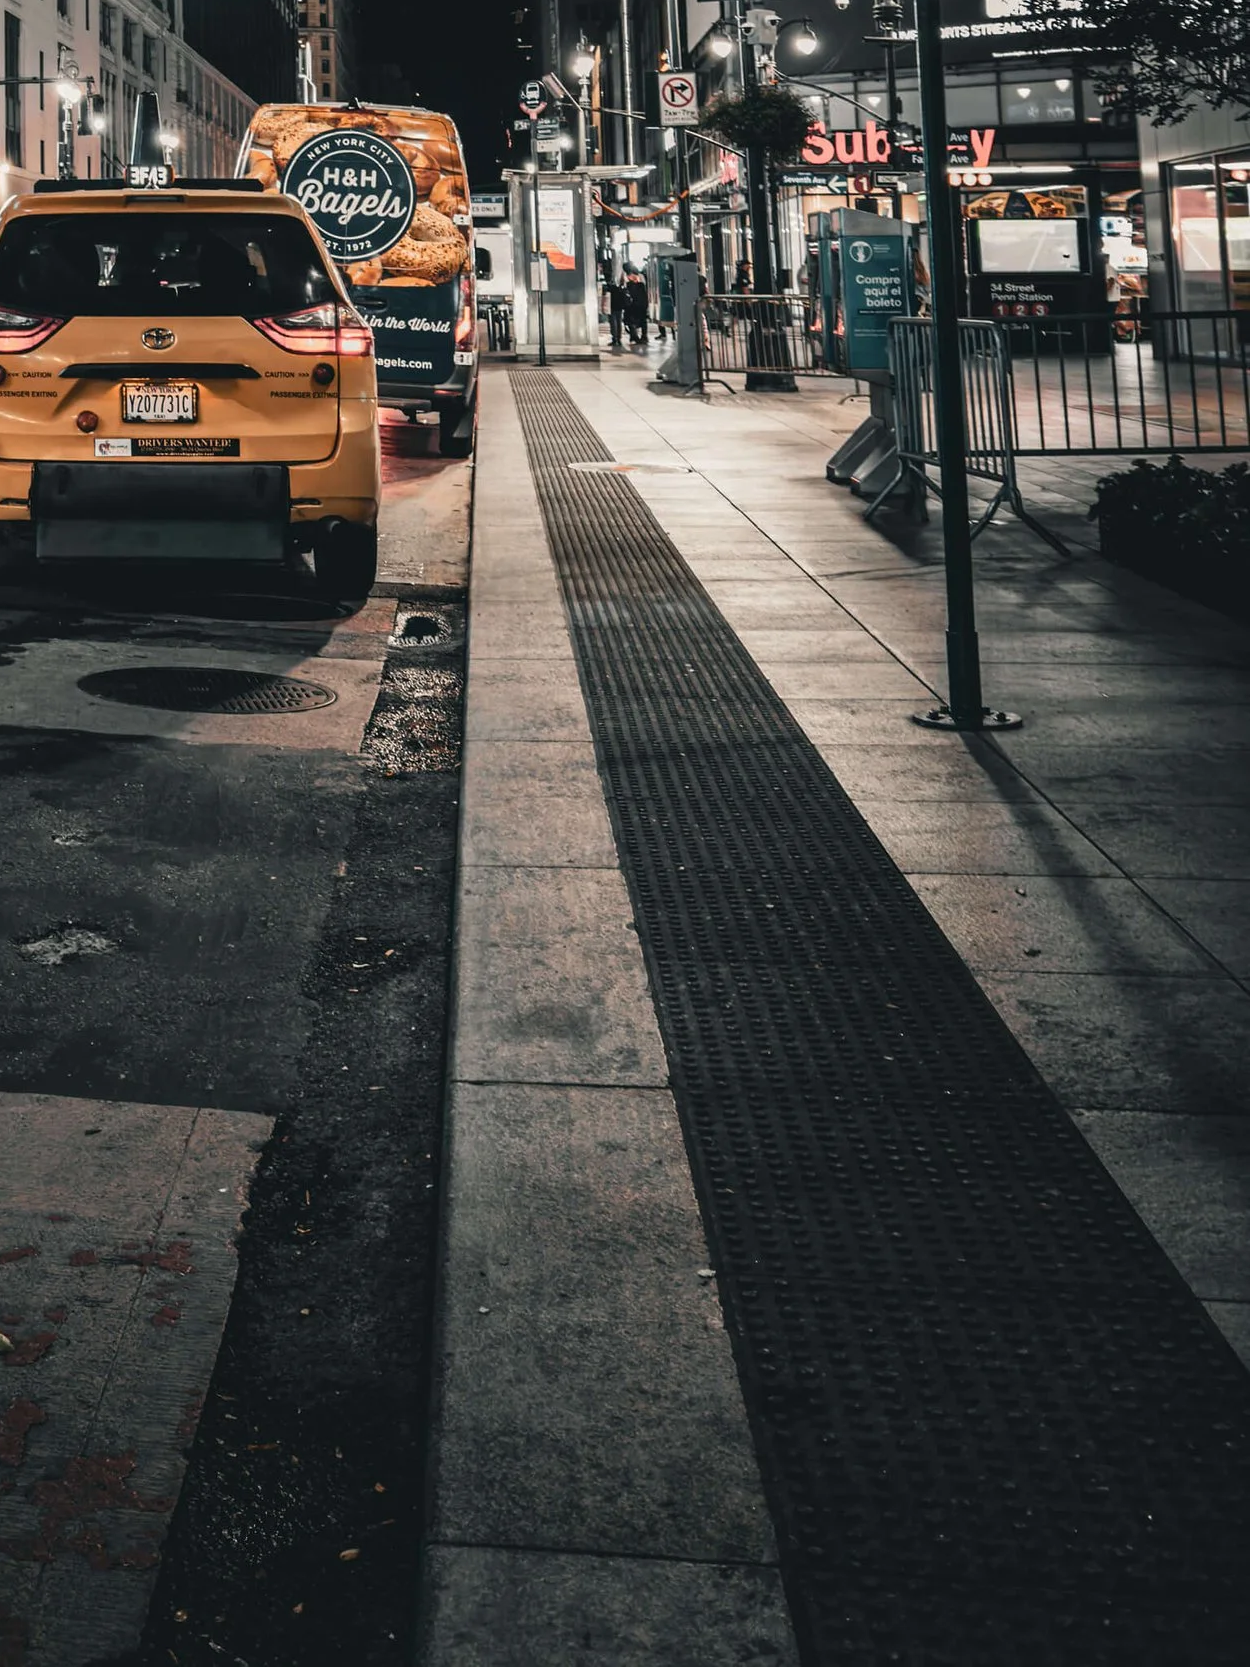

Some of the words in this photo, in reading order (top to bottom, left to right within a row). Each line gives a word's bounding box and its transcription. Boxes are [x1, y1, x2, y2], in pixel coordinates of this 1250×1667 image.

[950, 134, 969, 142] Ave
[802, 120, 995, 168] Suby
[306, 141, 330, 160] NEW
[334, 138, 366, 149] YORK
[369, 144, 394, 165] CITY
[950, 155, 969, 164] Ave
[323, 167, 378, 188] H&H
[783, 175, 812, 184] Seventh
[859, 177, 868, 191] 1
[297, 178, 407, 225] Bagels
[346, 240, 372, 252] 1972
[855, 275, 901, 285] Compre
[891, 286, 901, 295] el
[990, 283, 1003, 292] 34
[1005, 283, 1035, 292] Street
[991, 293, 1016, 301] Penn
[1018, 293, 1054, 301] Station
[866, 297, 902, 307] boleto
[370, 315, 384, 329] in
[385, 317, 407, 330] the
[407, 318, 451, 334] World
[375, 358, 433, 370] agels.com
[22, 371, 52, 379] CAUTION
[265, 371, 295, 379] CAUTION
[31, 390, 58, 398] EXITING
[270, 391, 311, 399] PASSENGER
[129, 395, 189, 413] Y207731C
[138, 438, 183, 447] DRIVERS
[185, 438, 232, 447] WANTED!
